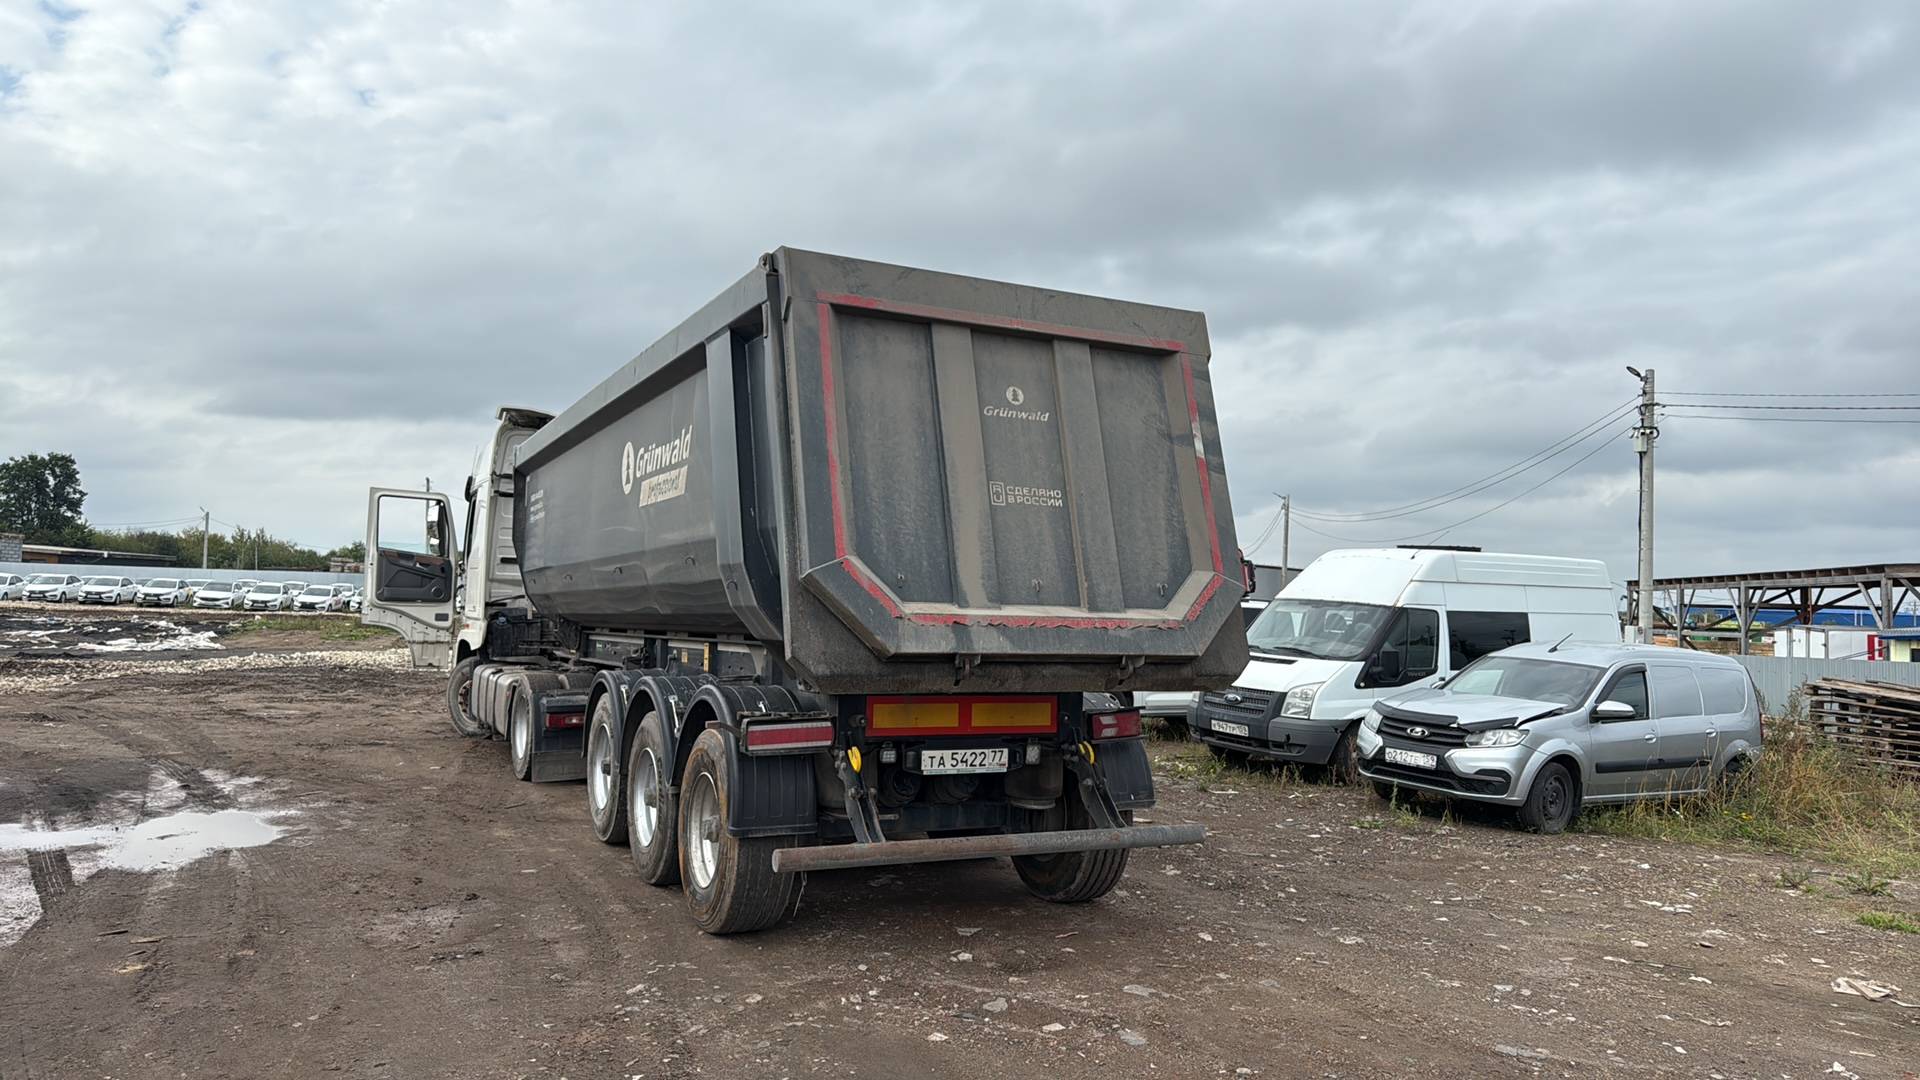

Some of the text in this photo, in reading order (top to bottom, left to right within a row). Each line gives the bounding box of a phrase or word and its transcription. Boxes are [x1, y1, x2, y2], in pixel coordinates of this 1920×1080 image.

[983, 405, 1050, 422] Grünwald
[635, 424, 693, 478] Grünwald
[1006, 486, 1062, 498] СДЕЛАНО
[1016, 495, 1063, 507] РОССИИ
[928, 750, 1004, 769] ТА 5422 77
